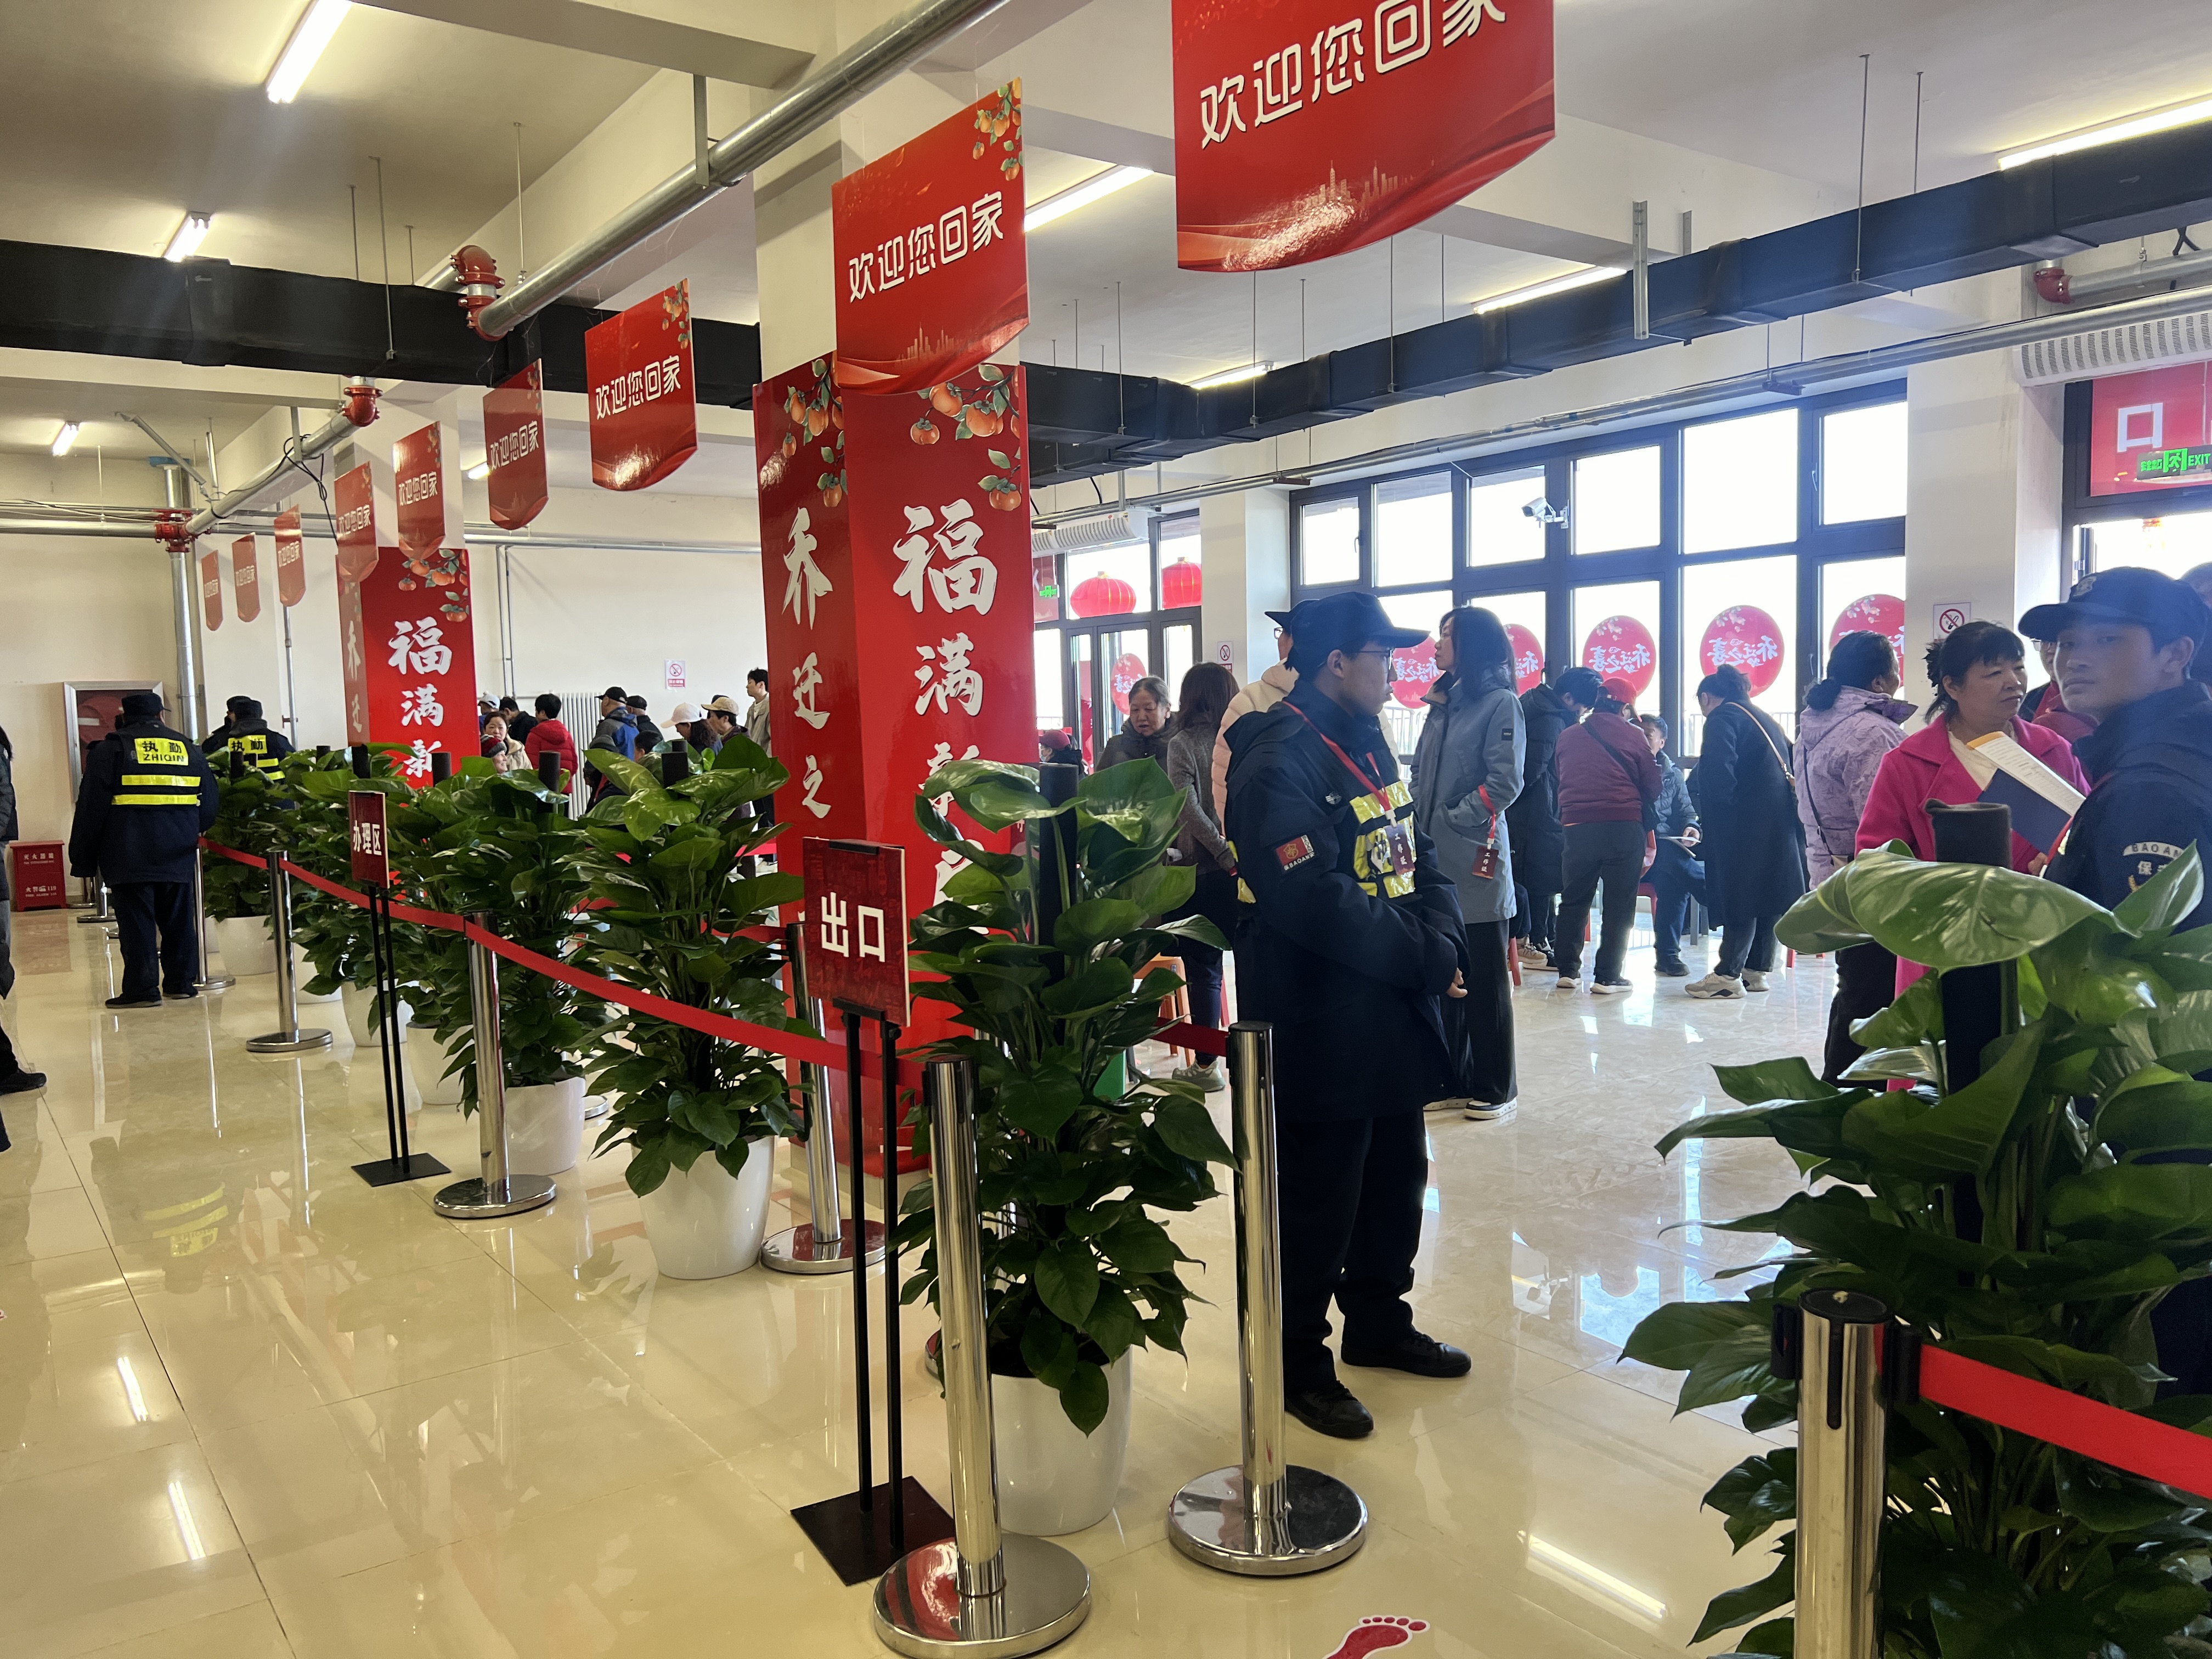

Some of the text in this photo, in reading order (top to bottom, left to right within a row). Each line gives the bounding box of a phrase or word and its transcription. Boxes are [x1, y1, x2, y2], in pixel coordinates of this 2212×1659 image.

[849, 190, 1004, 303] 欢迎您回家
[595, 355, 681, 420] 欢迎您回家
[490, 420, 539, 470] 欢迎您回家
[2188, 454, 2211, 466] EXIT
[398, 471, 438, 506] 欢迎您回家
[337, 504, 371, 539] 欢迎您回家
[781, 506, 833, 921] 乔迁之
[142, 741, 182, 753] 执勤
[143, 753, 184, 762] ZHIQIN
[353, 820, 382, 856] 办理区
[821, 892, 886, 963] 出口
